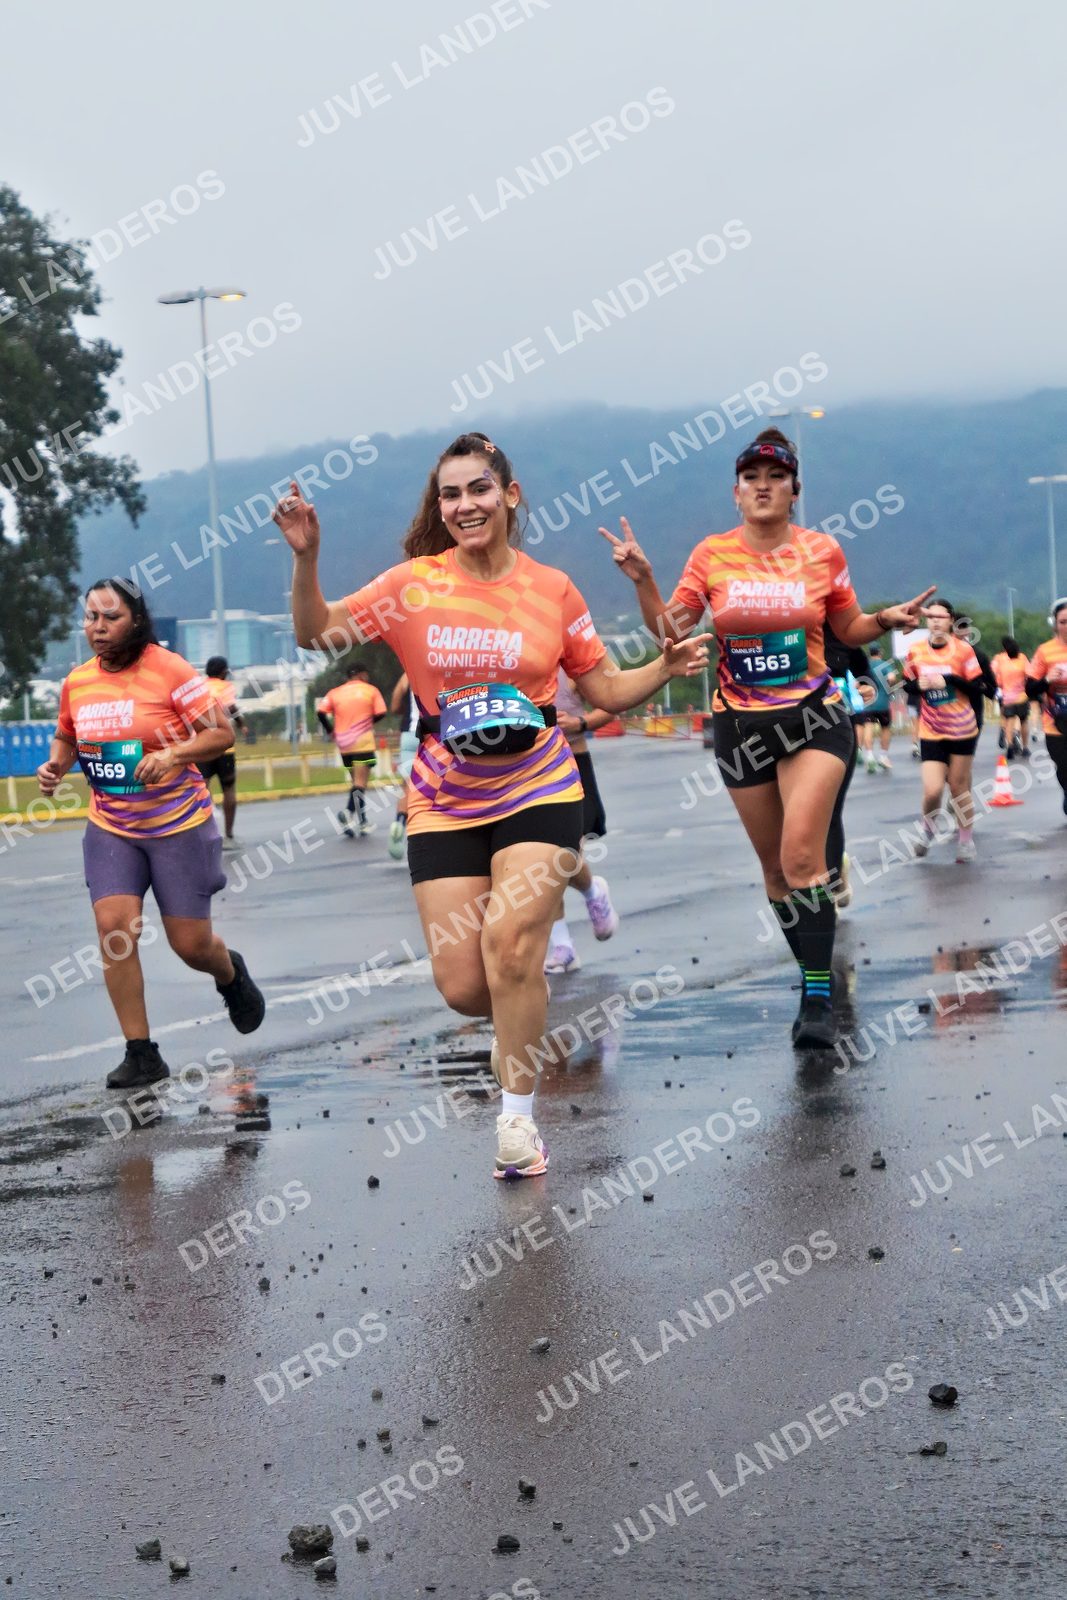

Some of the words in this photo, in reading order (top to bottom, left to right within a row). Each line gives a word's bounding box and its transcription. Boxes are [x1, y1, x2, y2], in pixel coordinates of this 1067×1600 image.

[729, 580, 806, 598] CARRERA
[727, 597, 789, 609] OMNILIFE
[427, 624, 523, 652] CARRERA
[730, 639, 763, 648] CARRERA
[784, 633, 799, 646] 10K
[427, 651, 498, 668] OMNILIFE
[743, 653, 791, 672] 1563
[446, 685, 489, 704] CARRERA
[446, 694, 480, 708] OMNILIFE
[77, 699, 134, 721] CARRERA
[459, 699, 521, 720] 1332
[76, 718, 118, 731] OMNILIFE
[121, 744, 137, 756] 10K
[87, 761, 126, 779] 1569
